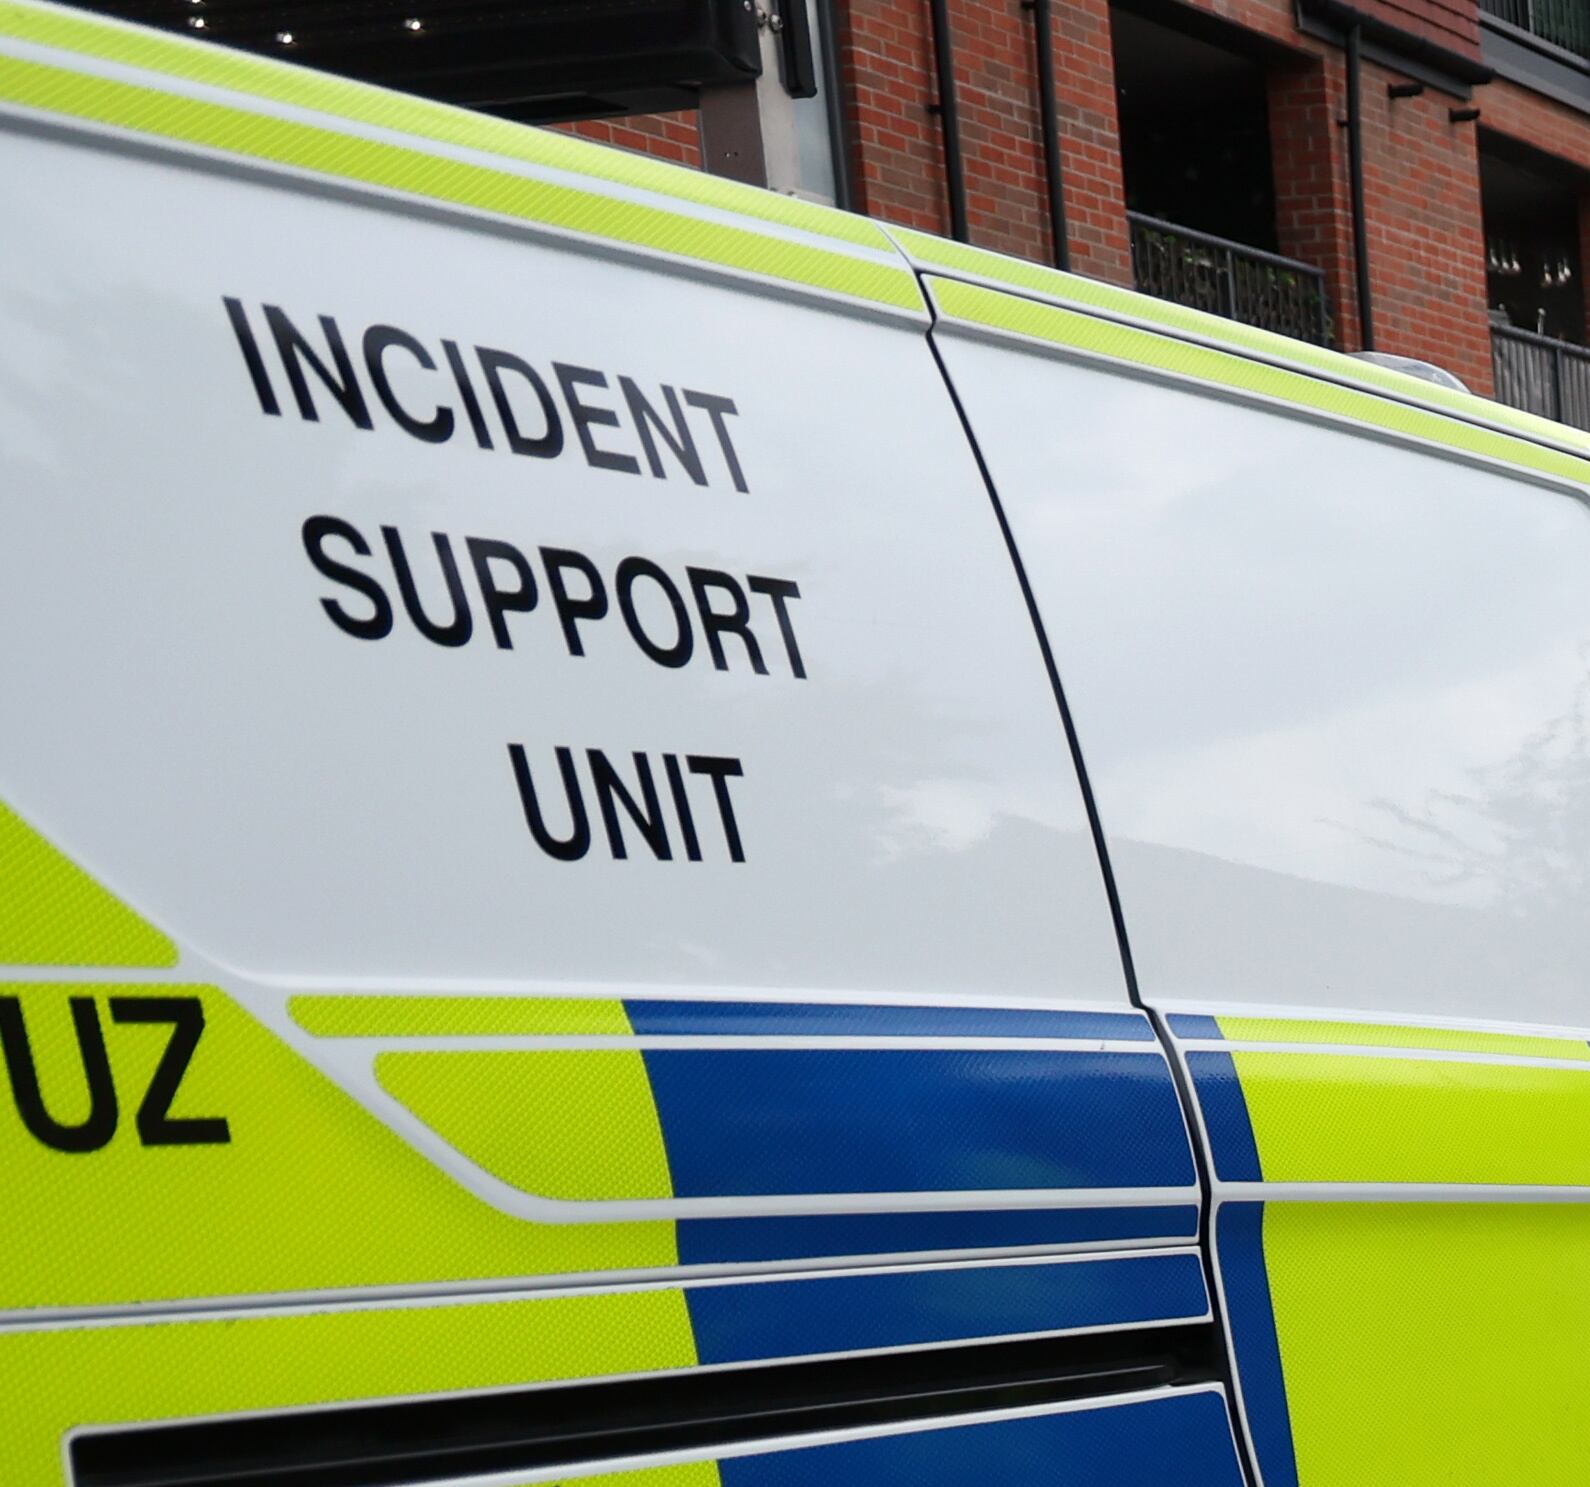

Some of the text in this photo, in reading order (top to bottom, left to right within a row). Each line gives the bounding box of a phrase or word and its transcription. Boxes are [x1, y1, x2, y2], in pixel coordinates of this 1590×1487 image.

[223, 296, 751, 495] INCIDENT
[301, 515, 808, 680] SUPPORT
[508, 742, 746, 864] UNIT
[0, 996, 231, 1154] UZ
